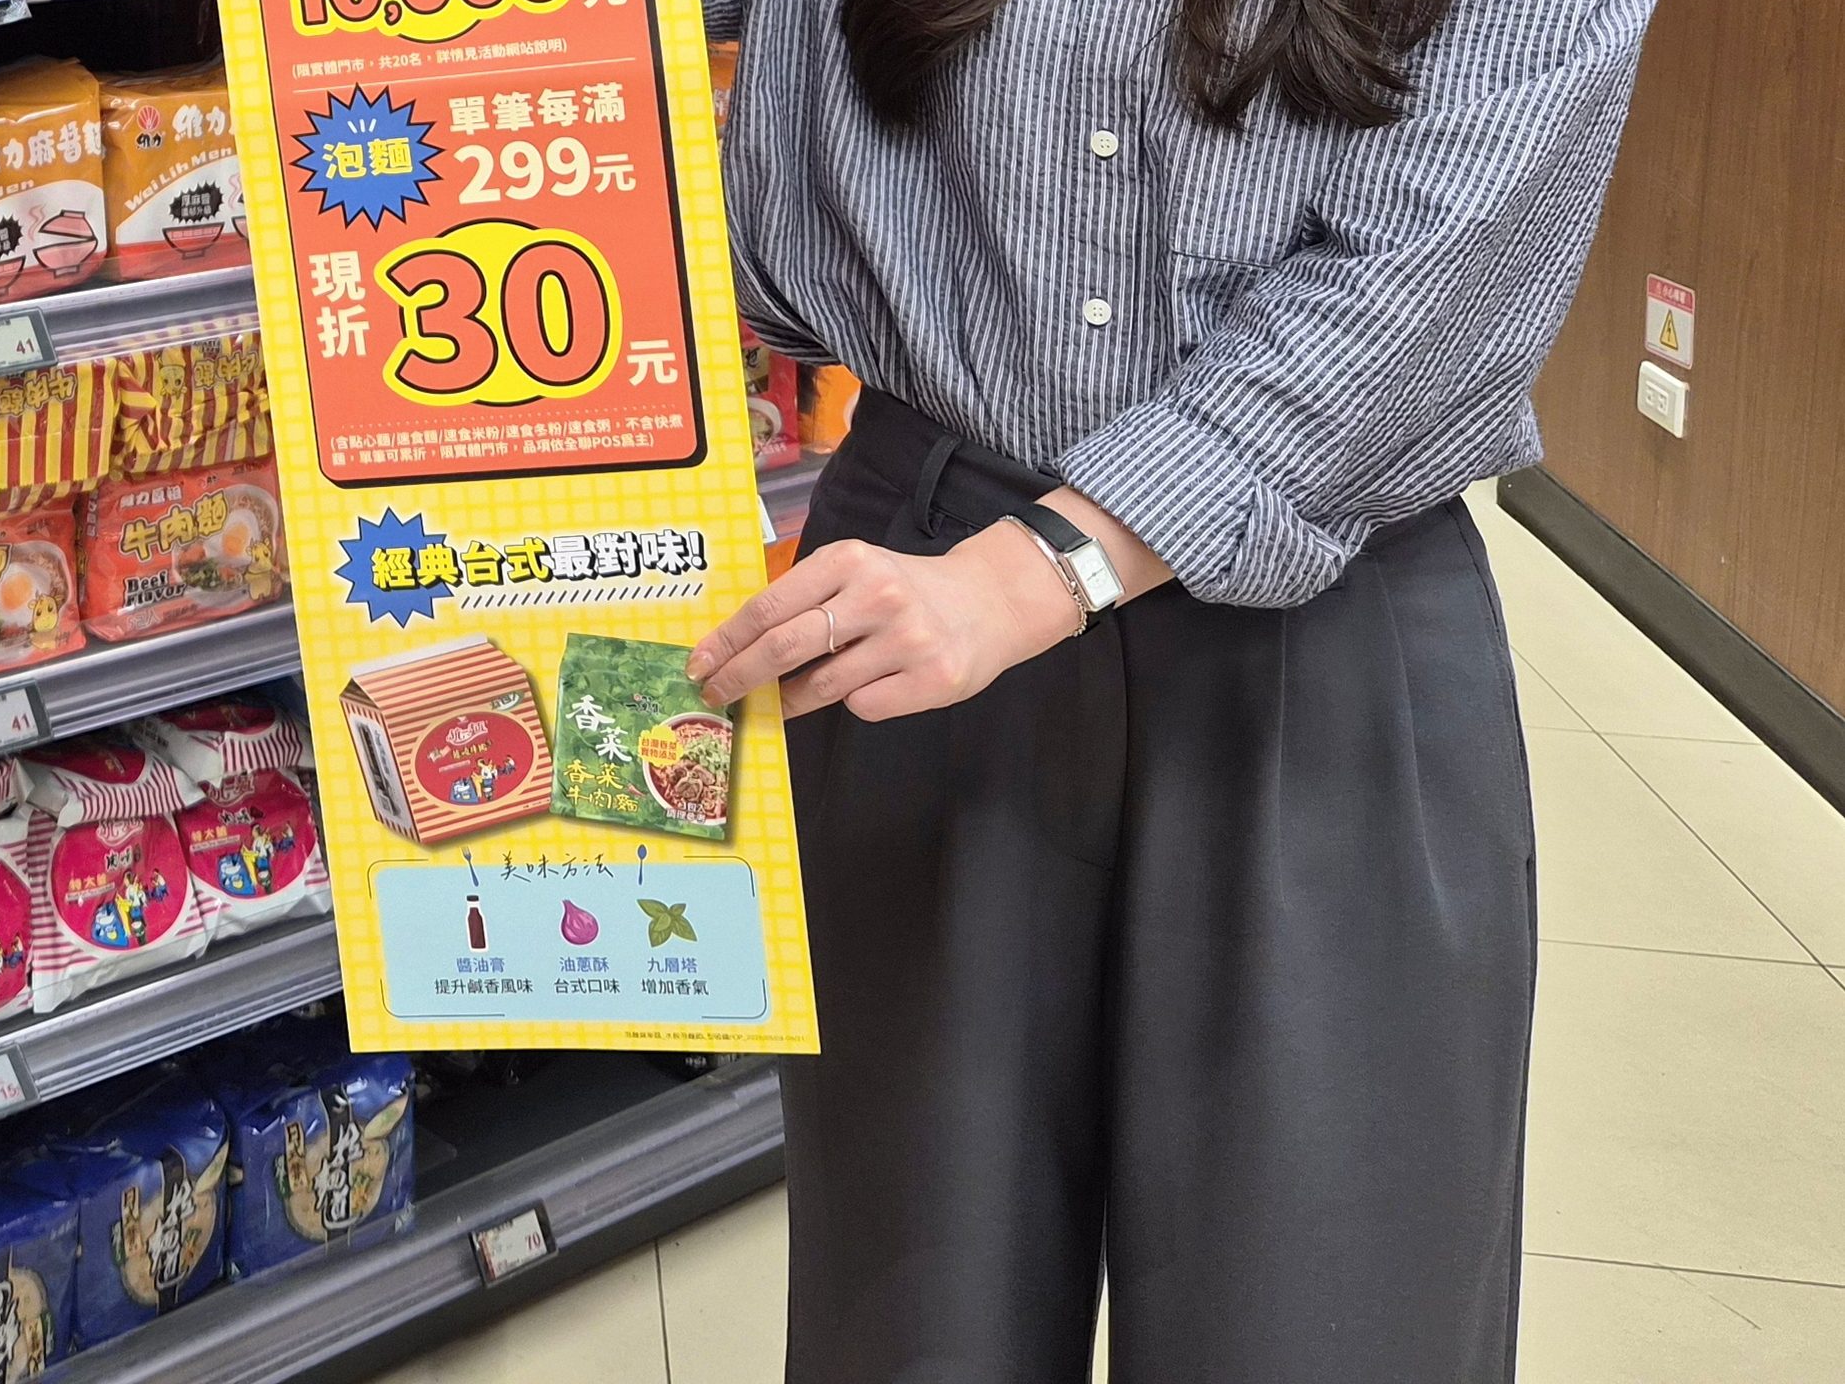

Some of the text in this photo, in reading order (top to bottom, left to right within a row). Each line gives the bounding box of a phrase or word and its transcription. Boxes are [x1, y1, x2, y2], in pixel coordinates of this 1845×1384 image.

[449, 81, 626, 134] 單筆每滿
[322, 137, 413, 179] 泡麵
[453, 135, 636, 205] 299元
[125, 145, 232, 212] Wei Lih Men
[309, 250, 370, 359] 現折
[386, 240, 679, 395] 30 元
[16, 337, 36, 355] 41
[122, 489, 228, 561] 牛肉麵
[372, 530, 708, 591] 經典台式最對味!
[123, 571, 167, 597] Beef
[11, 715, 30, 731] 41
[566, 694, 633, 762] 香菜
[564, 759, 624, 790] 香菜
[567, 786, 640, 813] 牛肉麵
[501, 852, 615, 882] 美味方法
[456, 957, 505, 974] 醬油膏
[560, 956, 610, 973] 油蔥酥
[647, 956, 698, 974] 九層塔
[435, 978, 533, 996] 提升鹹香風味
[554, 978, 620, 996] 台式口味
[642, 978, 709, 996] 增加香氣
[525, 1233, 542, 1252] 70
